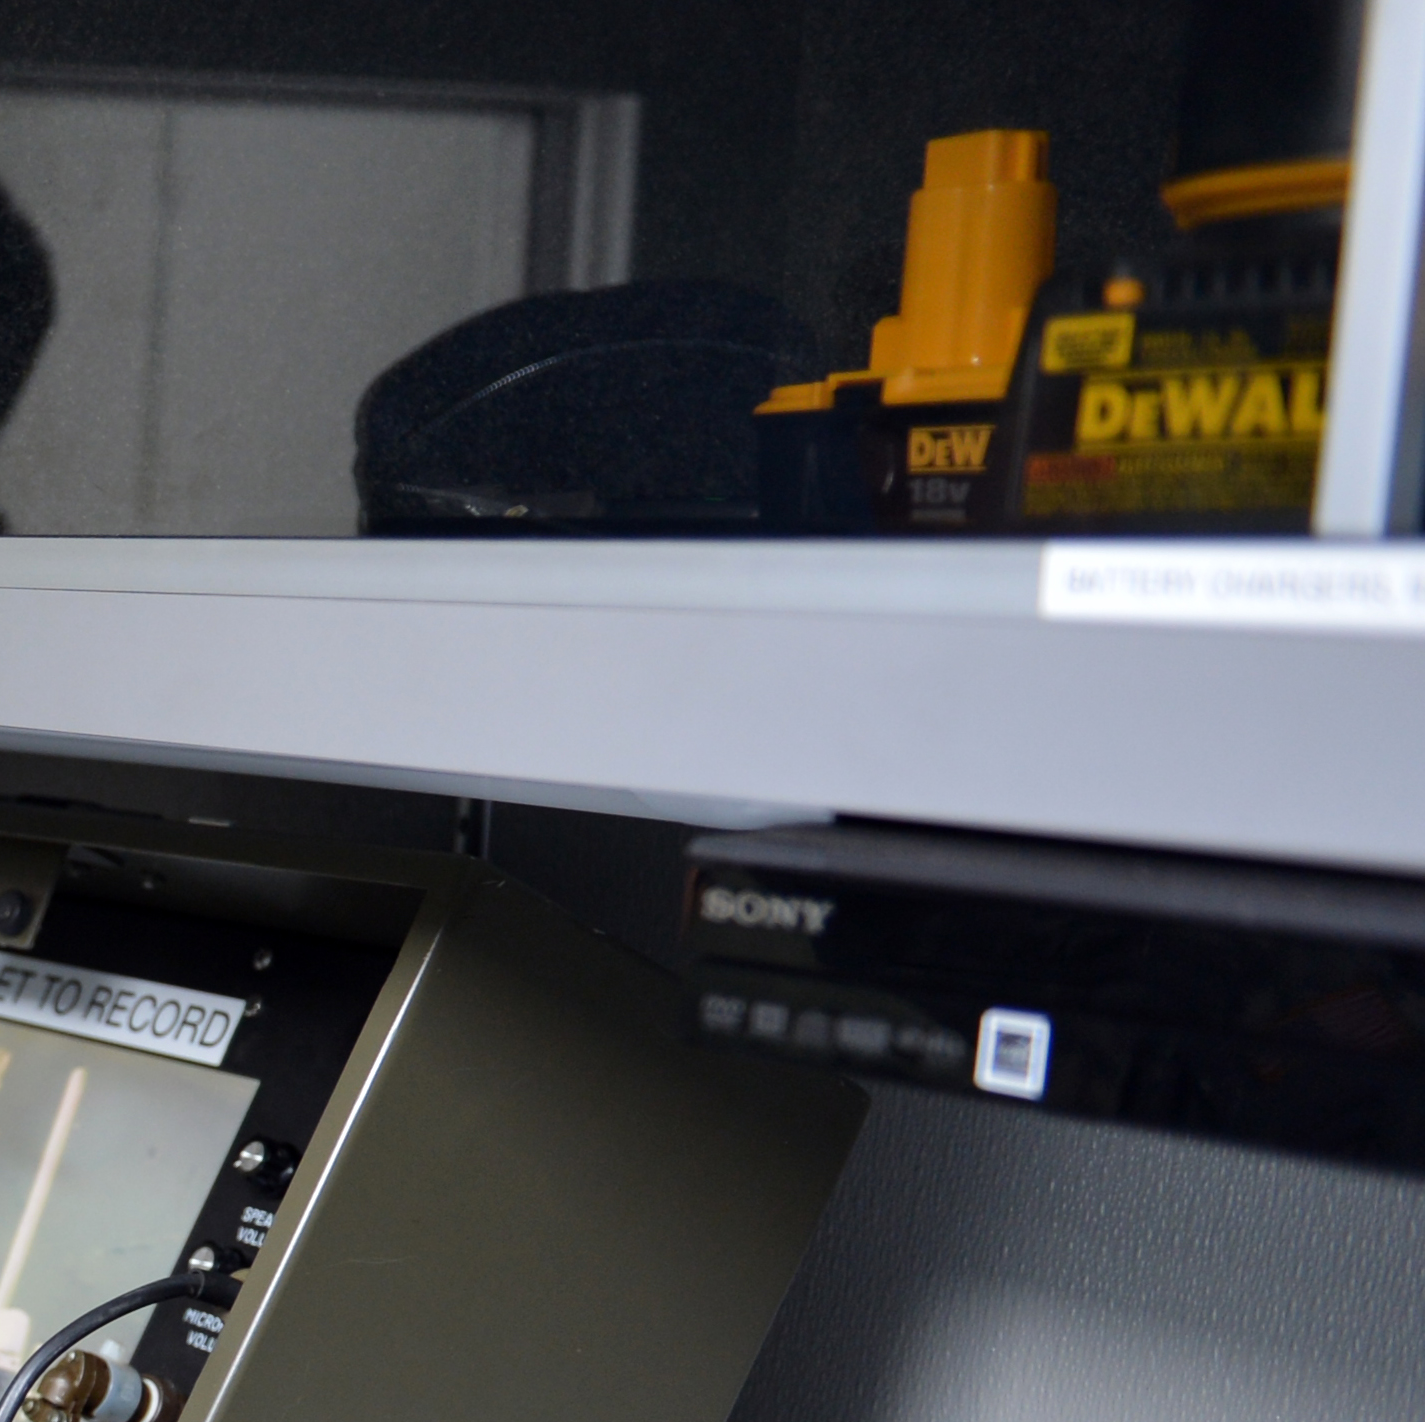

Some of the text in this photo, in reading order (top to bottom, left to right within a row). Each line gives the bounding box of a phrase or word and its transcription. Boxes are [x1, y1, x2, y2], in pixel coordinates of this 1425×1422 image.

[701, 887, 834, 936] SONY
[37, 974, 84, 1017] TO
[83, 985, 232, 1048] RECORD
